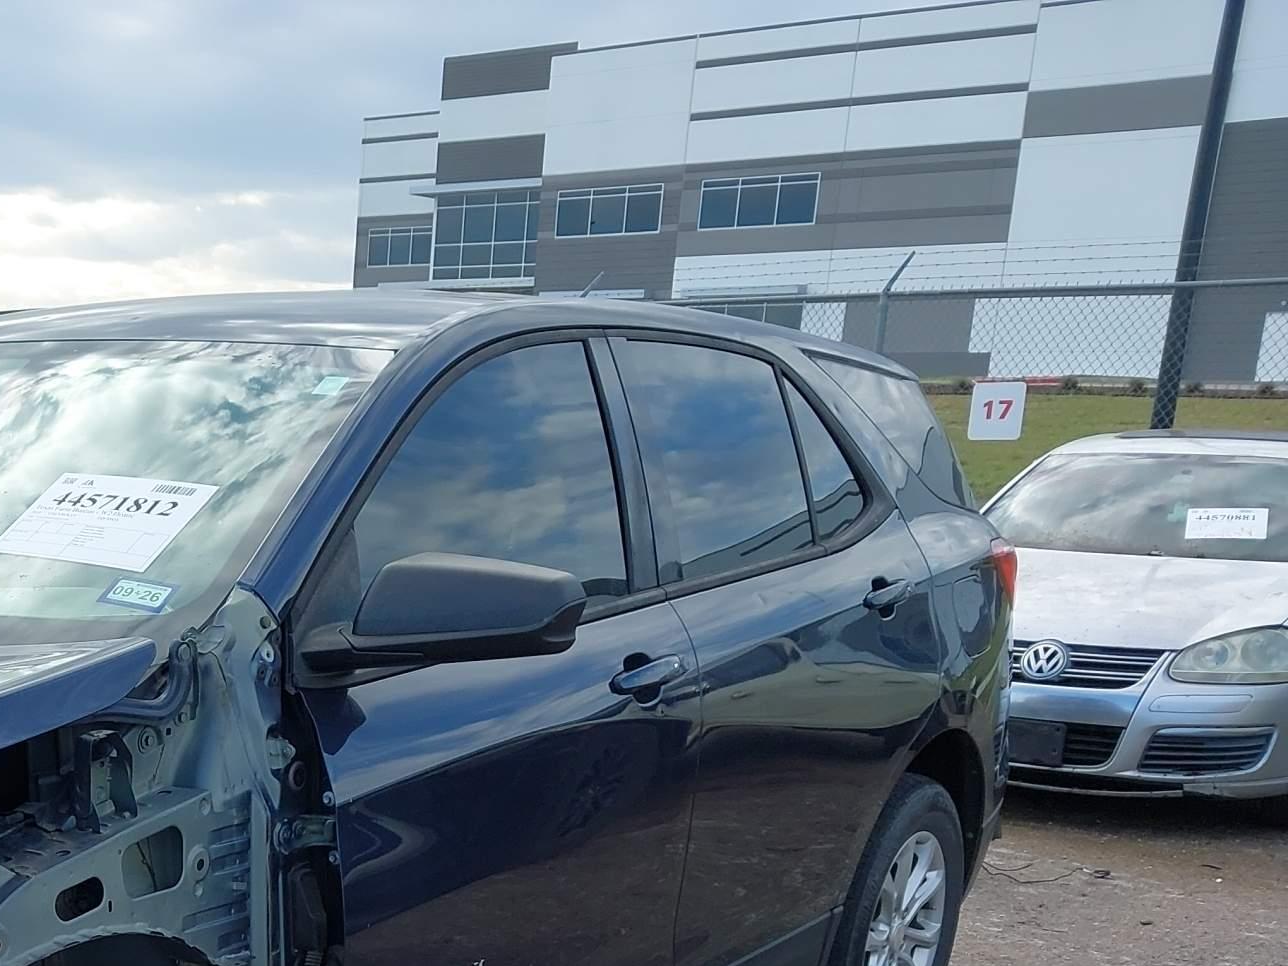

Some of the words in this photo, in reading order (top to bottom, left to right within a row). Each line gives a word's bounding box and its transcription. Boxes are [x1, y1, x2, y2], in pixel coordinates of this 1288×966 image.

[983, 400, 1014, 420] 17
[53, 491, 179, 517] 44571812
[1022, 643, 1065, 678] VW
